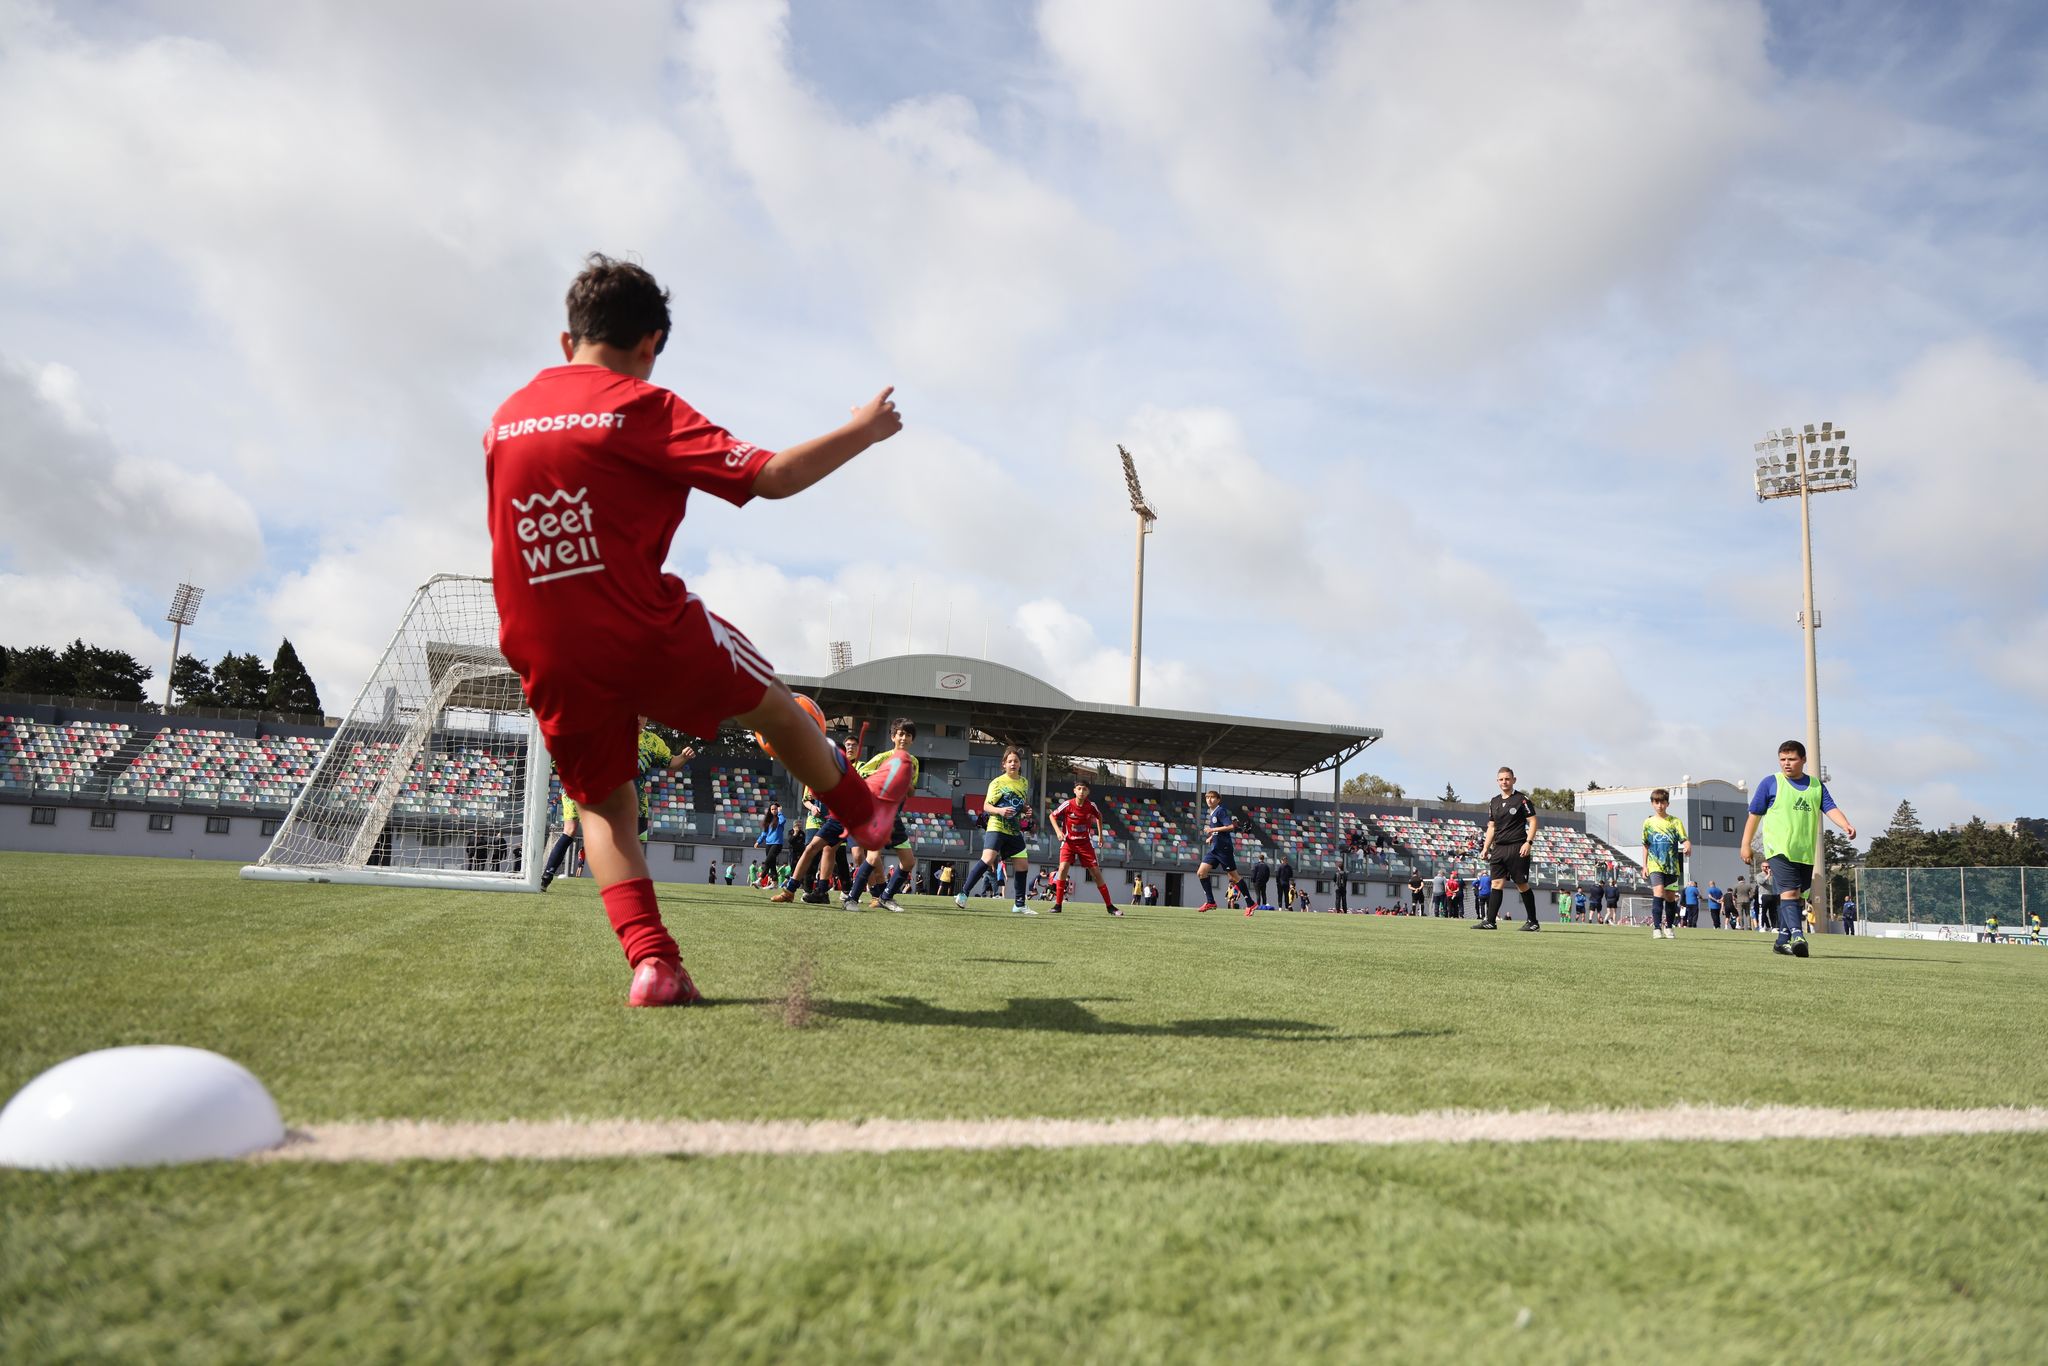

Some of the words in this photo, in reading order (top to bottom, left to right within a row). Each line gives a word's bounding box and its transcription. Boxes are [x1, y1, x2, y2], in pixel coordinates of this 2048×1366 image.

[497, 412, 626, 441] EUROSPORT
[517, 501, 593, 542] eeet
[522, 536, 600, 572] well
